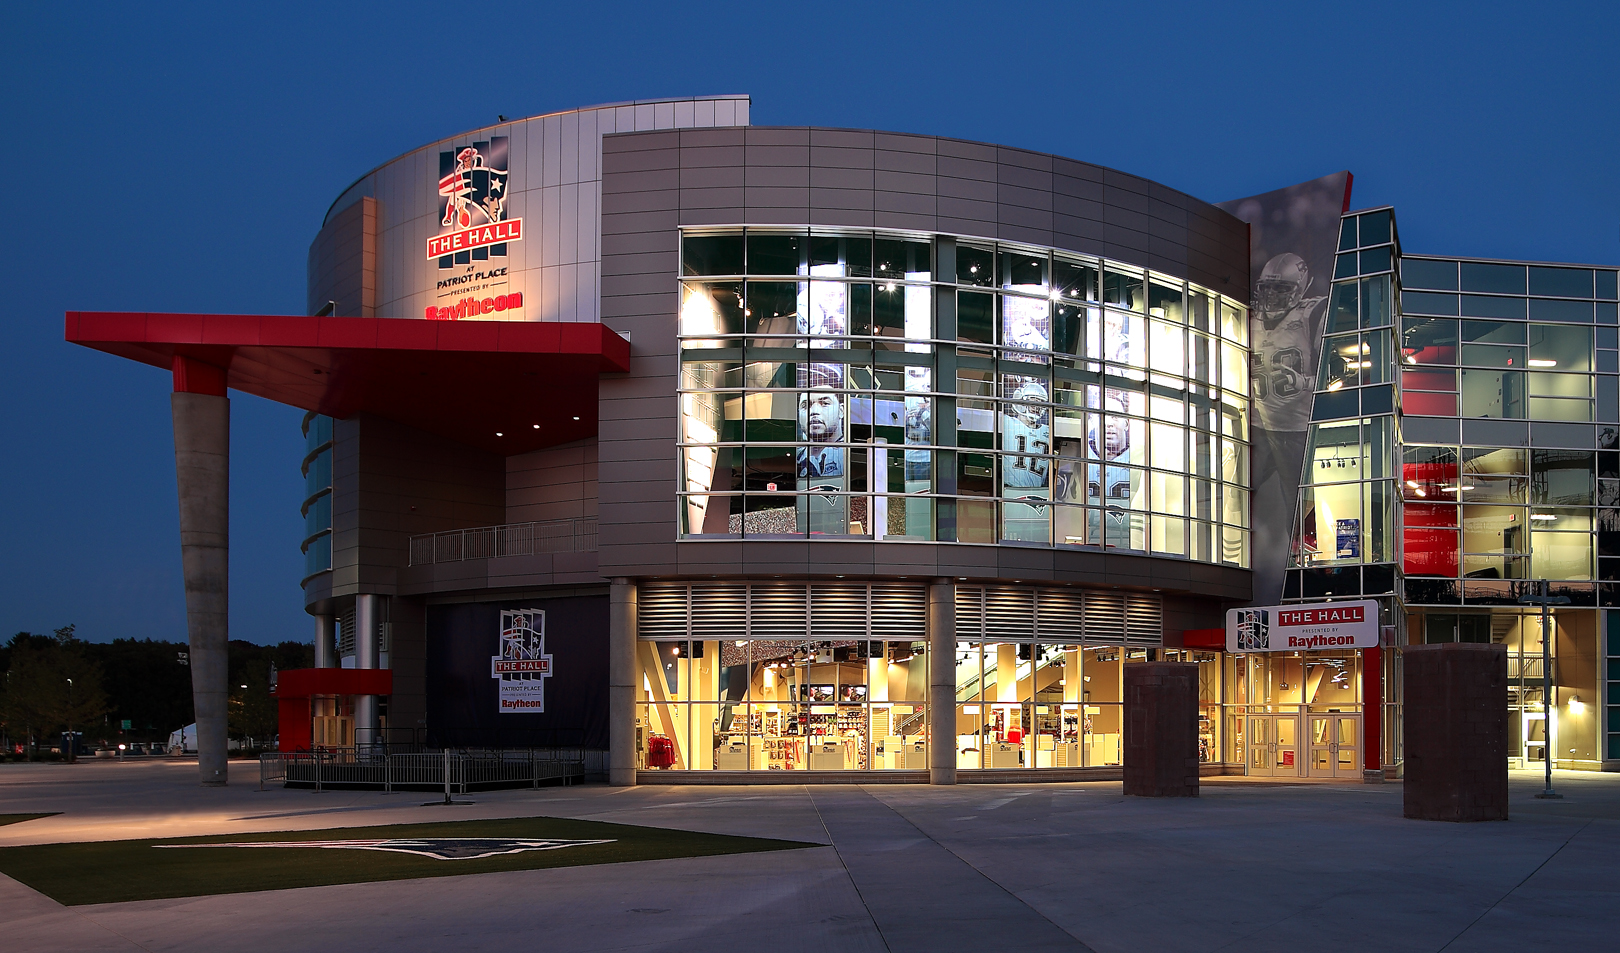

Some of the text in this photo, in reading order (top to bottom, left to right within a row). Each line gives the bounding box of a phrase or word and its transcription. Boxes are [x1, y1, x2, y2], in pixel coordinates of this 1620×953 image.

[430, 223, 519, 254] THE HALL
[436, 267, 508, 290] PATRIOT PLACE
[450, 286, 480, 296] PRESENTED
[425, 291, 523, 320] Raytheon
[1013, 434, 1049, 477] 12
[1281, 609, 1362, 624] THE HALL
[1288, 635, 1355, 648] Raytheon
[520, 662, 546, 670] HALL
[502, 700, 540, 709] Raytheon
